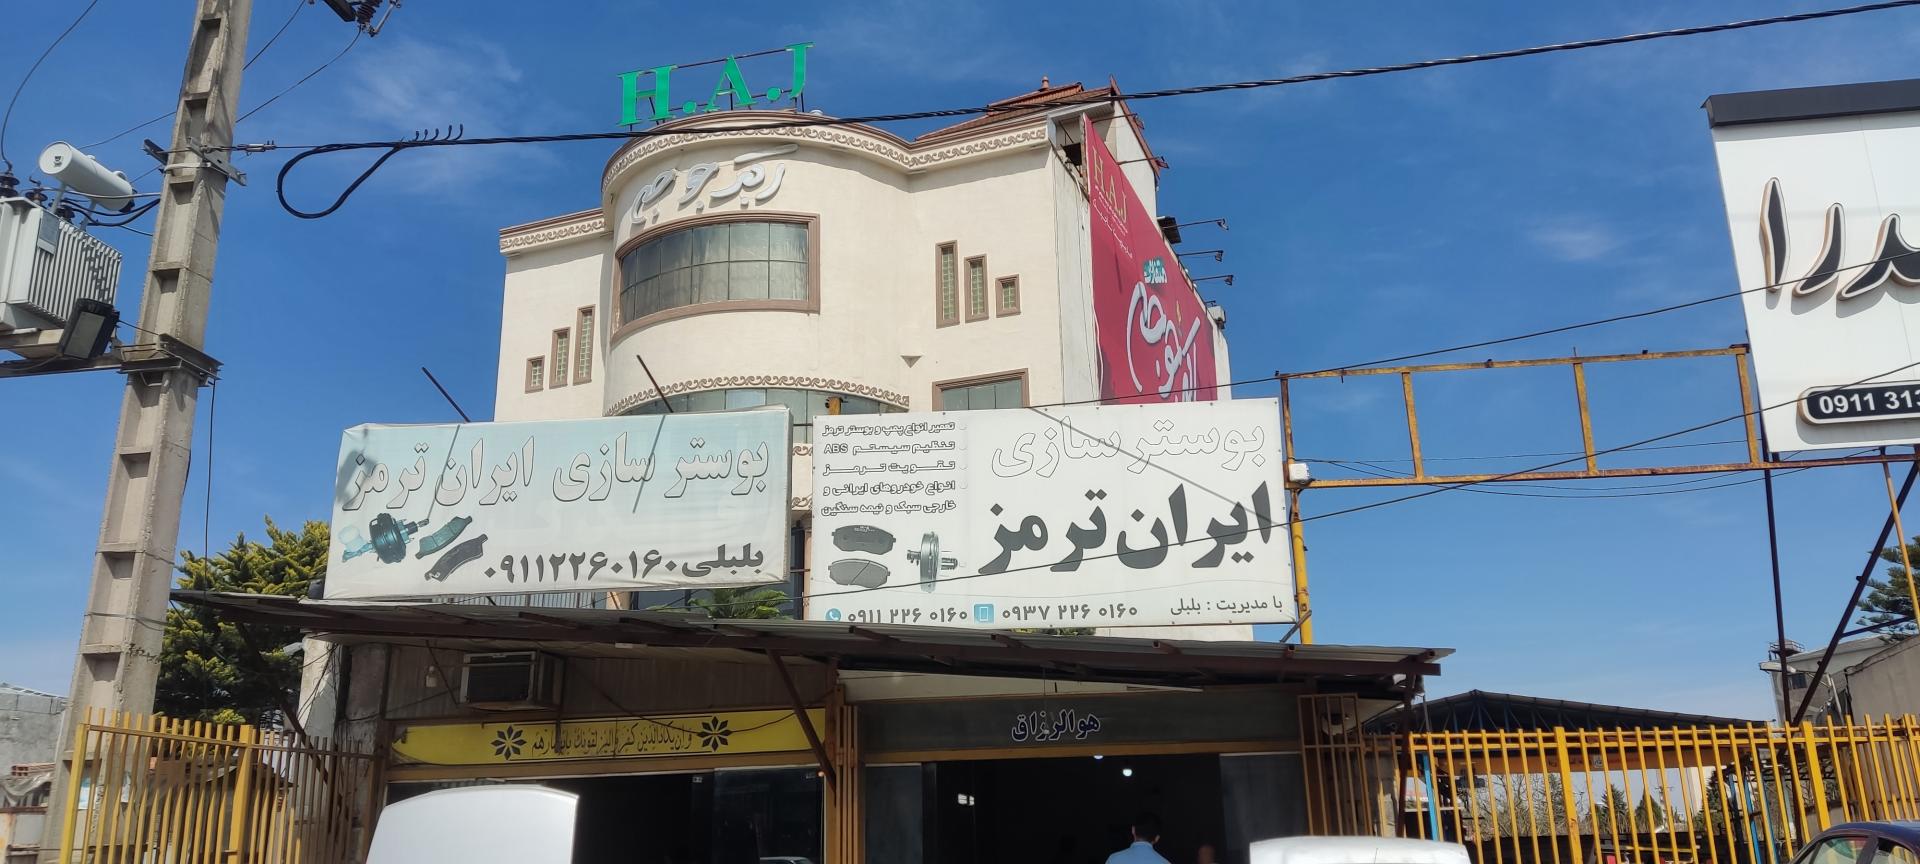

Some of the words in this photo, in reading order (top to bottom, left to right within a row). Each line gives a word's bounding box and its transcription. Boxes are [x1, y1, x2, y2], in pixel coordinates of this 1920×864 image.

[616, 41, 816, 127] H.A.J
[1819, 393, 1876, 414] 0911
[822, 425, 845, 437] ترمز
[845, 425, 874, 436] بوستر
[874, 426, 881, 435] و
[904, 422, 928, 436] انواع
[928, 421, 956, 434] تعمیر
[824, 443, 849, 454] ABS
[852, 443, 911, 455] سیستم
[912, 440, 956, 454] تنظیم
[991, 415, 1122, 478] سازی
[1127, 418, 1266, 475] بوستر
[434, 436, 536, 507] ایران
[552, 431, 657, 503] سازی
[664, 438, 770, 499] بوستر
[823, 463, 887, 476] ترمز
[888, 459, 956, 474] تقویت
[341, 441, 430, 512] ترمز
[823, 486, 831, 496] و
[832, 483, 869, 496] ایرانی
[869, 480, 925, 495] خودروهای
[925, 480, 956, 496] انواع
[821, 501, 859, 517] سنگین
[860, 503, 884, 515] نیمه
[885, 504, 893, 514] و
[893, 501, 922, 514] سبک
[922, 500, 957, 514] خارجی
[978, 488, 1108, 576] ترمز
[1116, 480, 1273, 570] ایران
[484, 548, 678, 585] ۰۹۱۱۲۲۶۰۱۶۰
[682, 542, 765, 579] بلبلی
[1170, 597, 1202, 617] بلبلی
[1215, 600, 1269, 614] مدیریت
[1272, 595, 1283, 612] با
[889, 608, 922, 623] ۲۲۶
[929, 607, 968, 623] ۰۱۶۰
[1002, 604, 1051, 621] ۰۹۳۷
[1058, 603, 1091, 620] ۲۲۶
[1098, 602, 1138, 619] ۰۱۶۰
